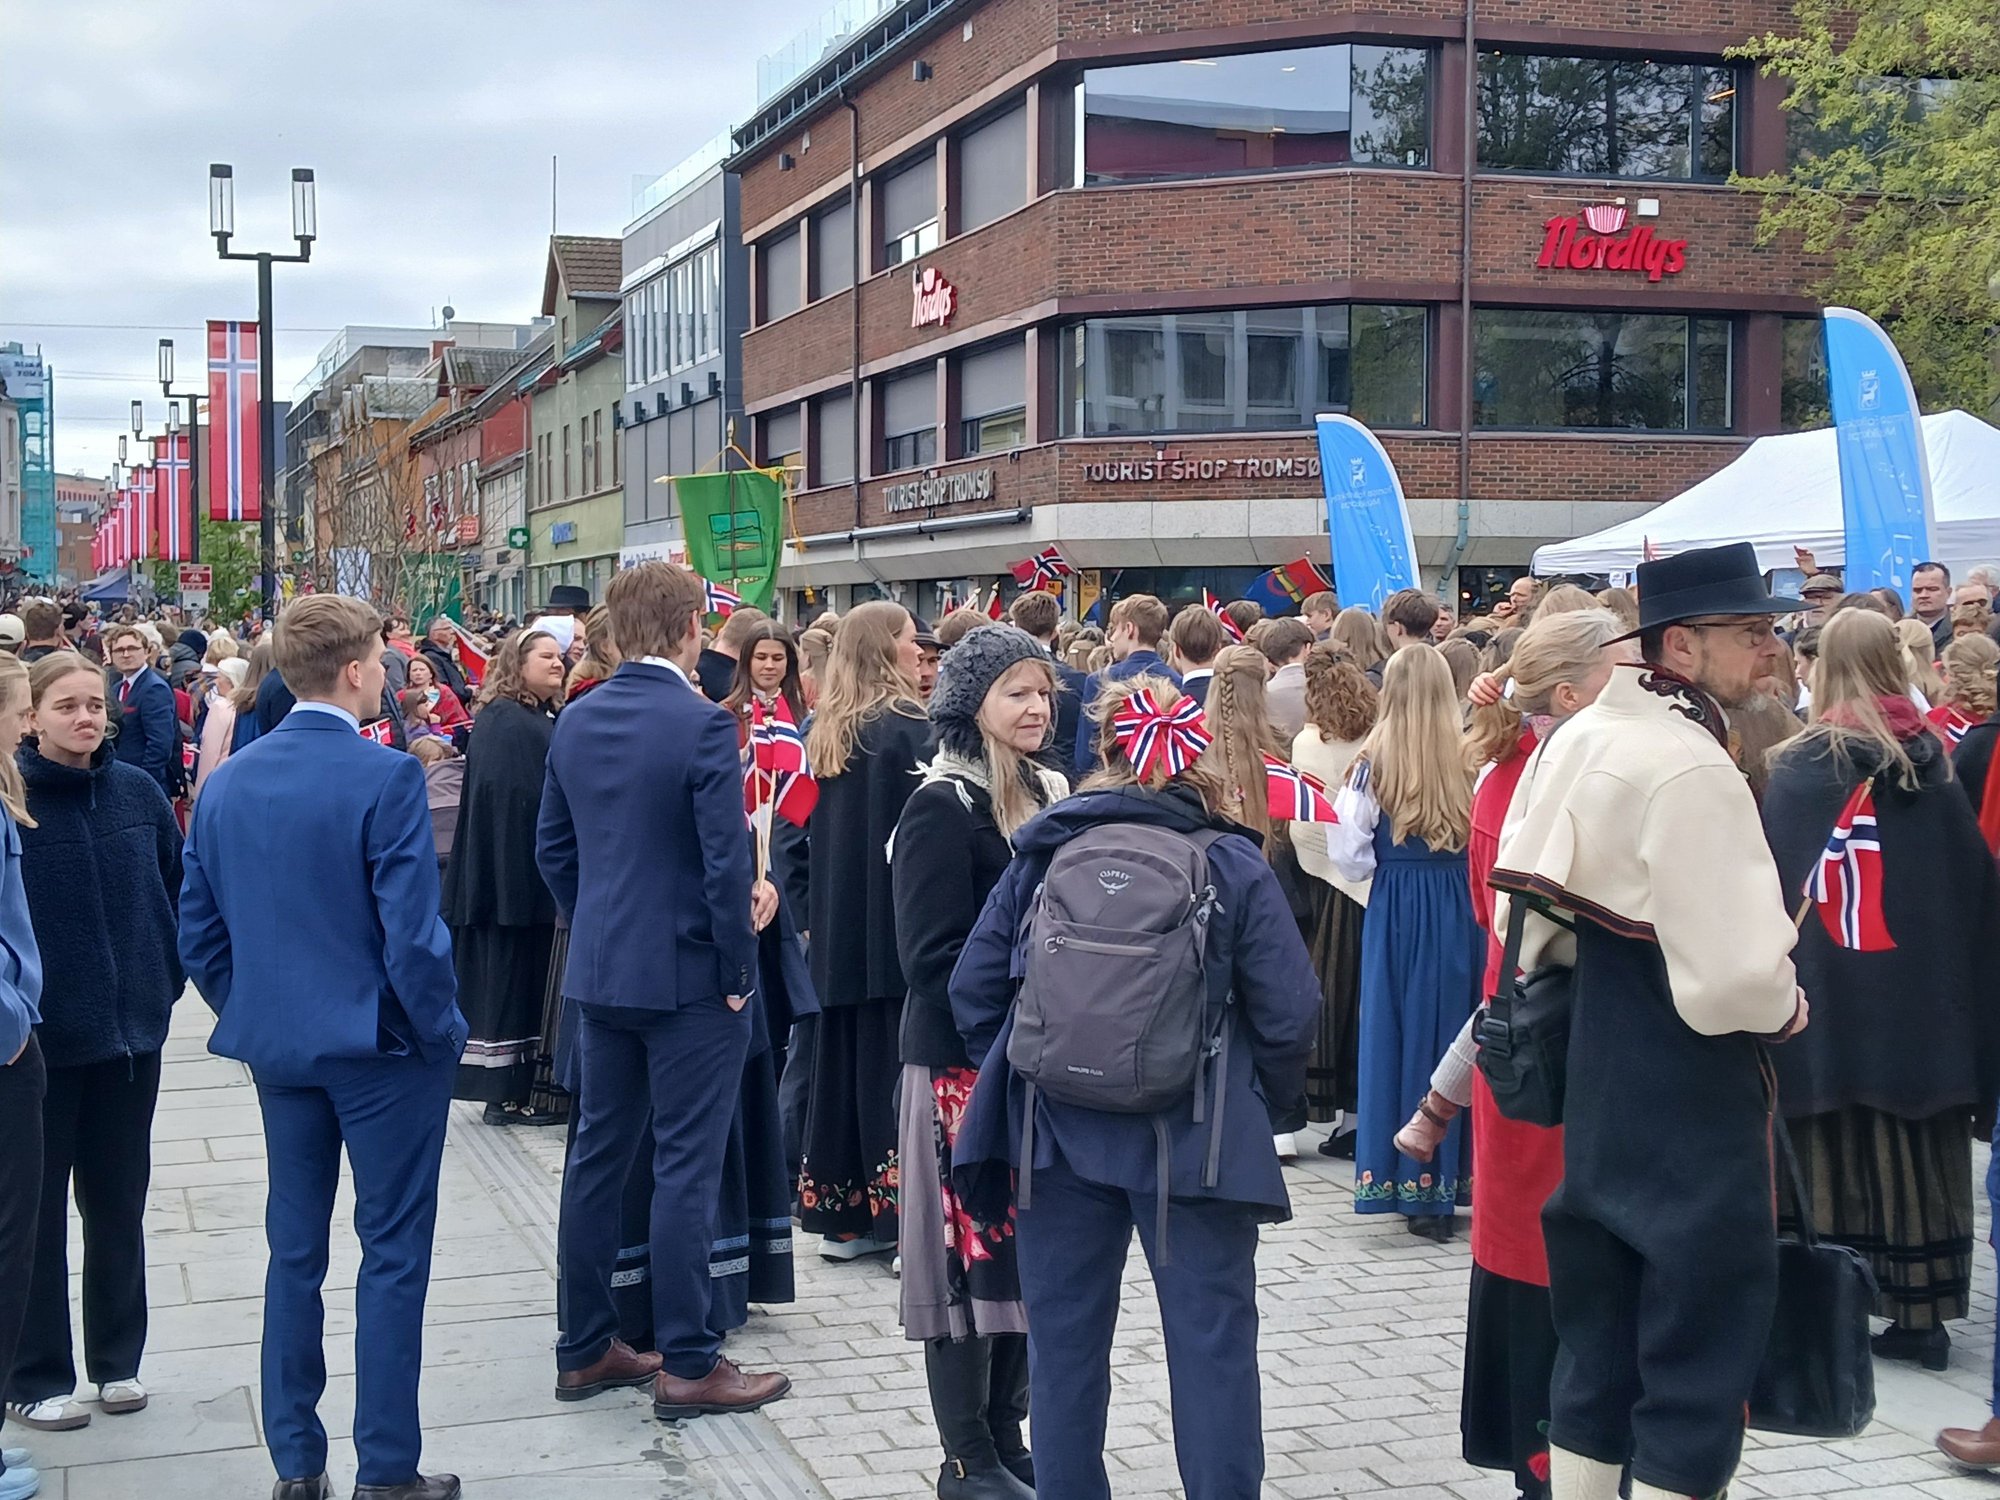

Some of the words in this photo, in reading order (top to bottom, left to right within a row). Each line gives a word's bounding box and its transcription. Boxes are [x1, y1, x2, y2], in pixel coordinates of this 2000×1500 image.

[1537, 215, 1688, 282] Nordlys
[911, 275, 956, 328] Nordlys
[882, 481, 919, 513] TOURIST
[920, 478, 947, 507] SHOP
[946, 467, 990, 503] TROMSØ
[1083, 461, 1167, 482] TOURIST
[1171, 458, 1229, 480] SHOP
[1231, 456, 1320, 479] TROMSØ
[1099, 870, 1131, 881] OSPREY
